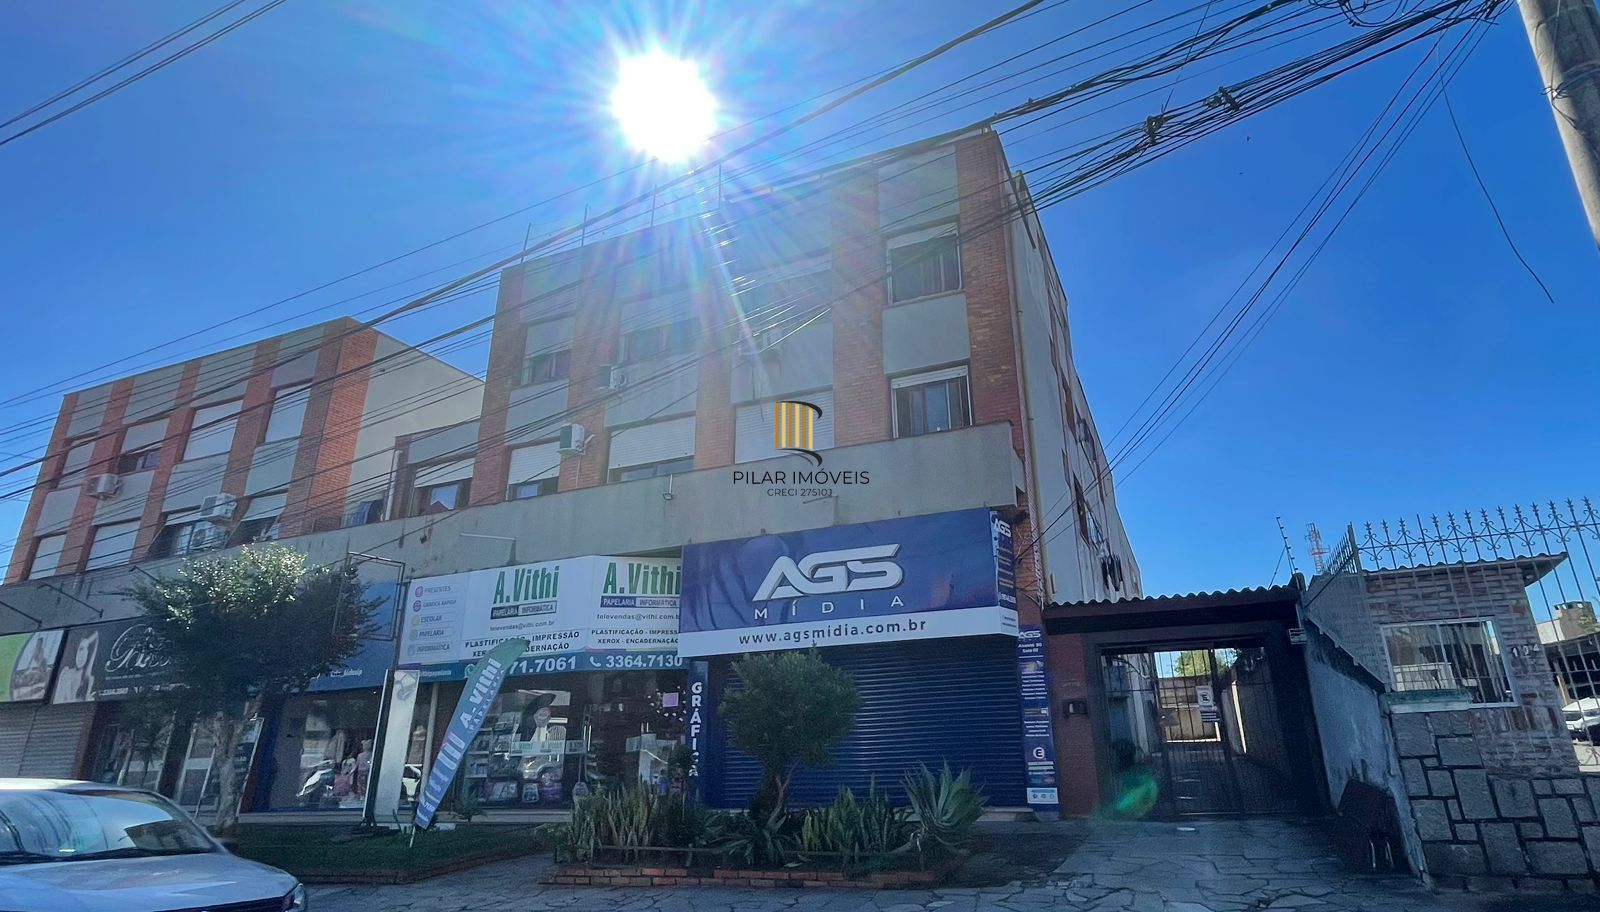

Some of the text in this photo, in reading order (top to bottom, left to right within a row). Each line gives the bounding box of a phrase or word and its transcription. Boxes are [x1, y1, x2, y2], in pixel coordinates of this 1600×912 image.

[994, 518, 1012, 538] AGS
[602, 562, 681, 595] A.Vithi
[752, 543, 904, 601] AGS
[493, 565, 560, 604] A.Vithi
[603, 598, 677, 607] PAPELARIA INFORMÁTICA
[754, 596, 904, 620] MÍDIA
[597, 613, 680, 622] televendas@vithi.com.b
[532, 631, 580, 642] IMPRESSÃO
[591, 628, 643, 636] PLASTIFICAÇÃO
[1018, 630, 1041, 639] AGS
[606, 654, 683, 668] 3364.7130
